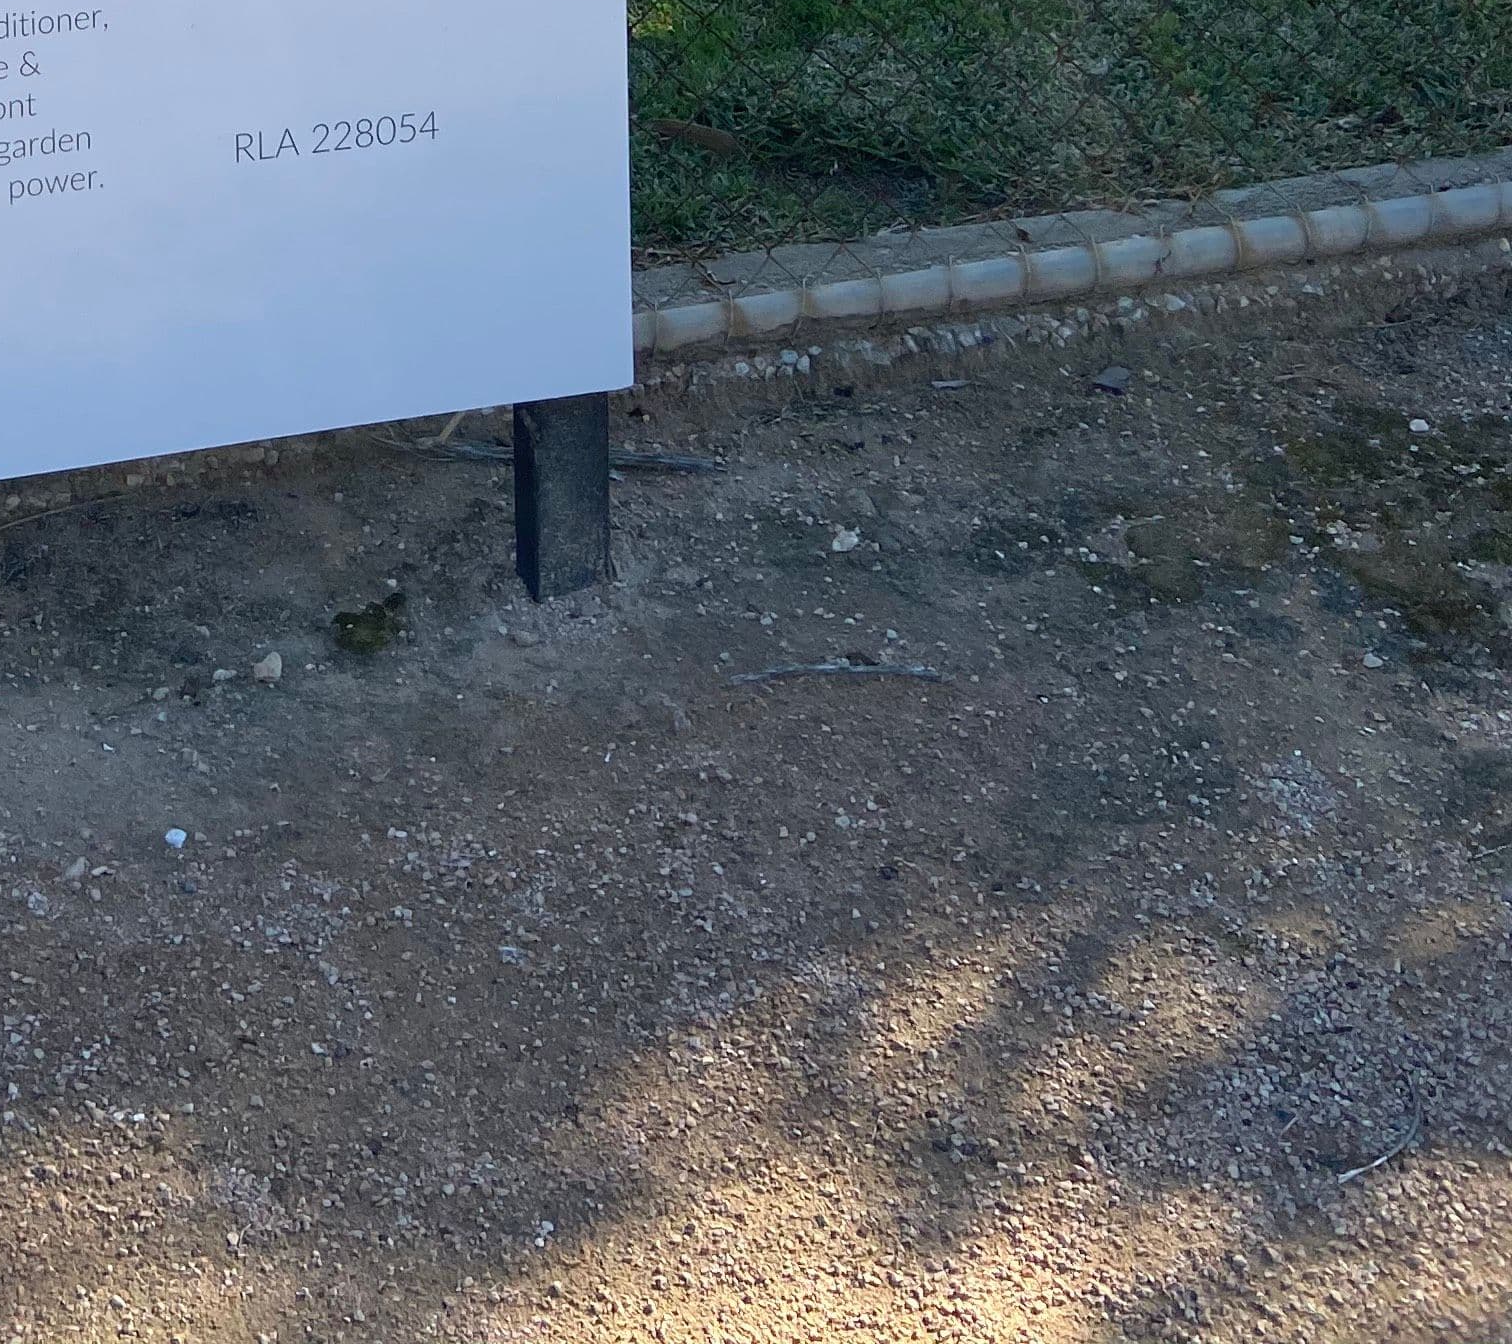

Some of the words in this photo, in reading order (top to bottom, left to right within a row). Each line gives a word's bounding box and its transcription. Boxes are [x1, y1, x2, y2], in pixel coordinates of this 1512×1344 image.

[20, 51, 41, 76] &
[236, 128, 299, 163] RLA
[312, 111, 439, 153] 228054
[10, 171, 103, 205] power.
